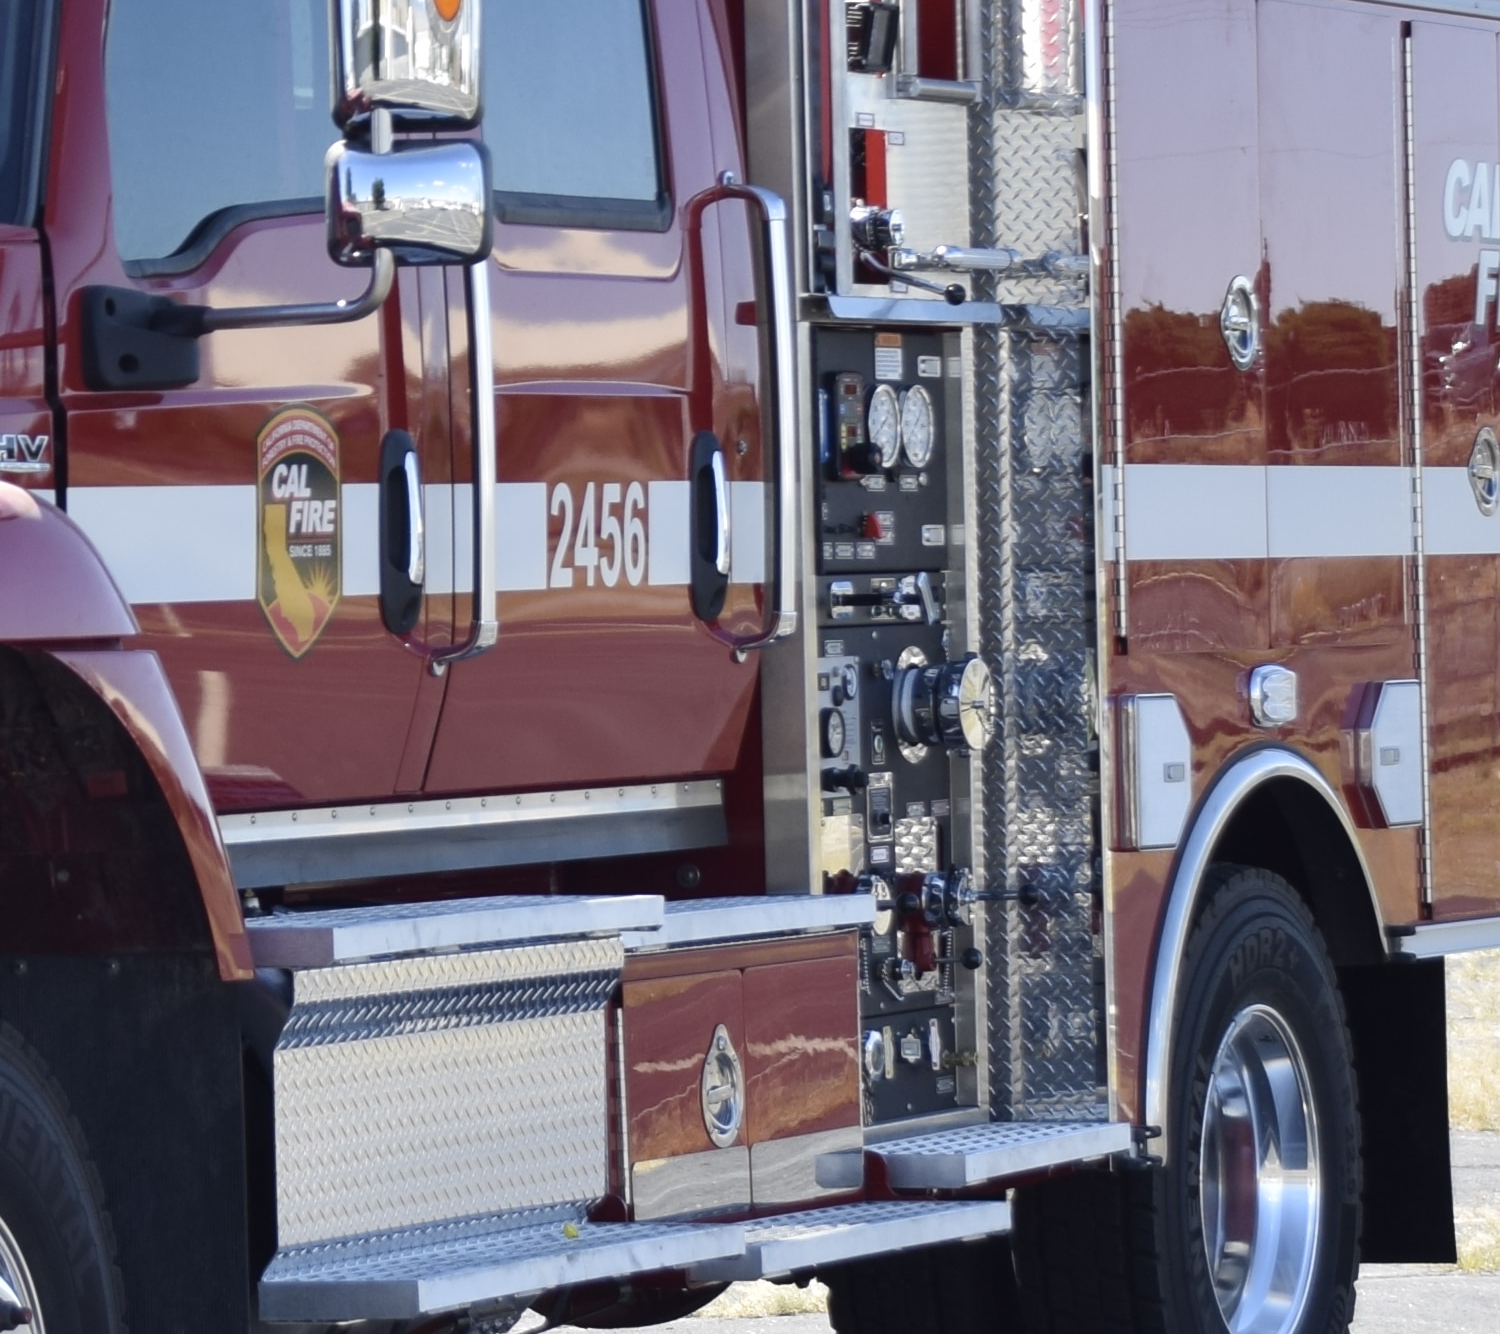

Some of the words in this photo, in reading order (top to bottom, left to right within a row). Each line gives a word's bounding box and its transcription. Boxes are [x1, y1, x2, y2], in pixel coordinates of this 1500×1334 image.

[272, 464, 311, 498] CAL
[289, 500, 336, 533] FIRE
[289, 545, 313, 558] SINCE
[549, 481, 648, 589] 2456
